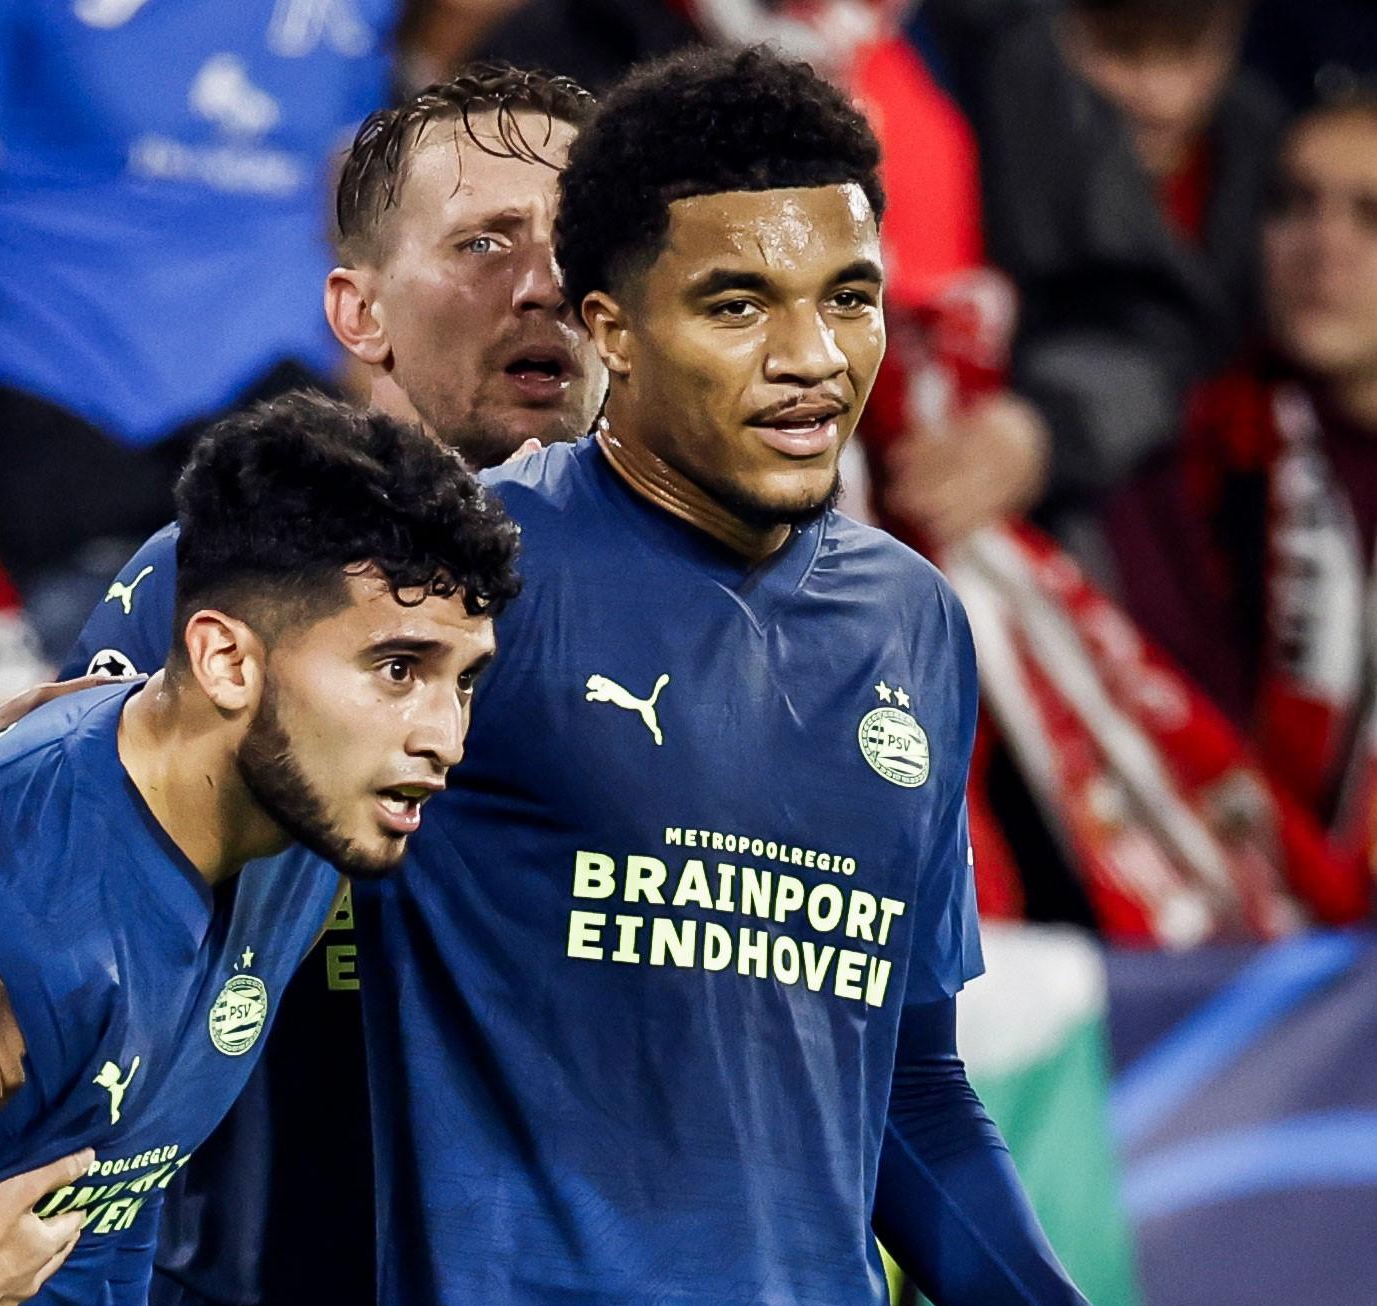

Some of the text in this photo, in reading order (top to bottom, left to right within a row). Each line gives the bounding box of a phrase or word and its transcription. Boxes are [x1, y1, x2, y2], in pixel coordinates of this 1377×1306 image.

[887, 734, 911, 752] PSV
[665, 827, 857, 876] METROPOOLREGIO
[572, 850, 906, 946] BRAINPORT
[566, 910, 892, 1008] EINDHOVEN
[229, 1003, 252, 1020] PSV
[85, 1144, 179, 1177] POOLREGIO
